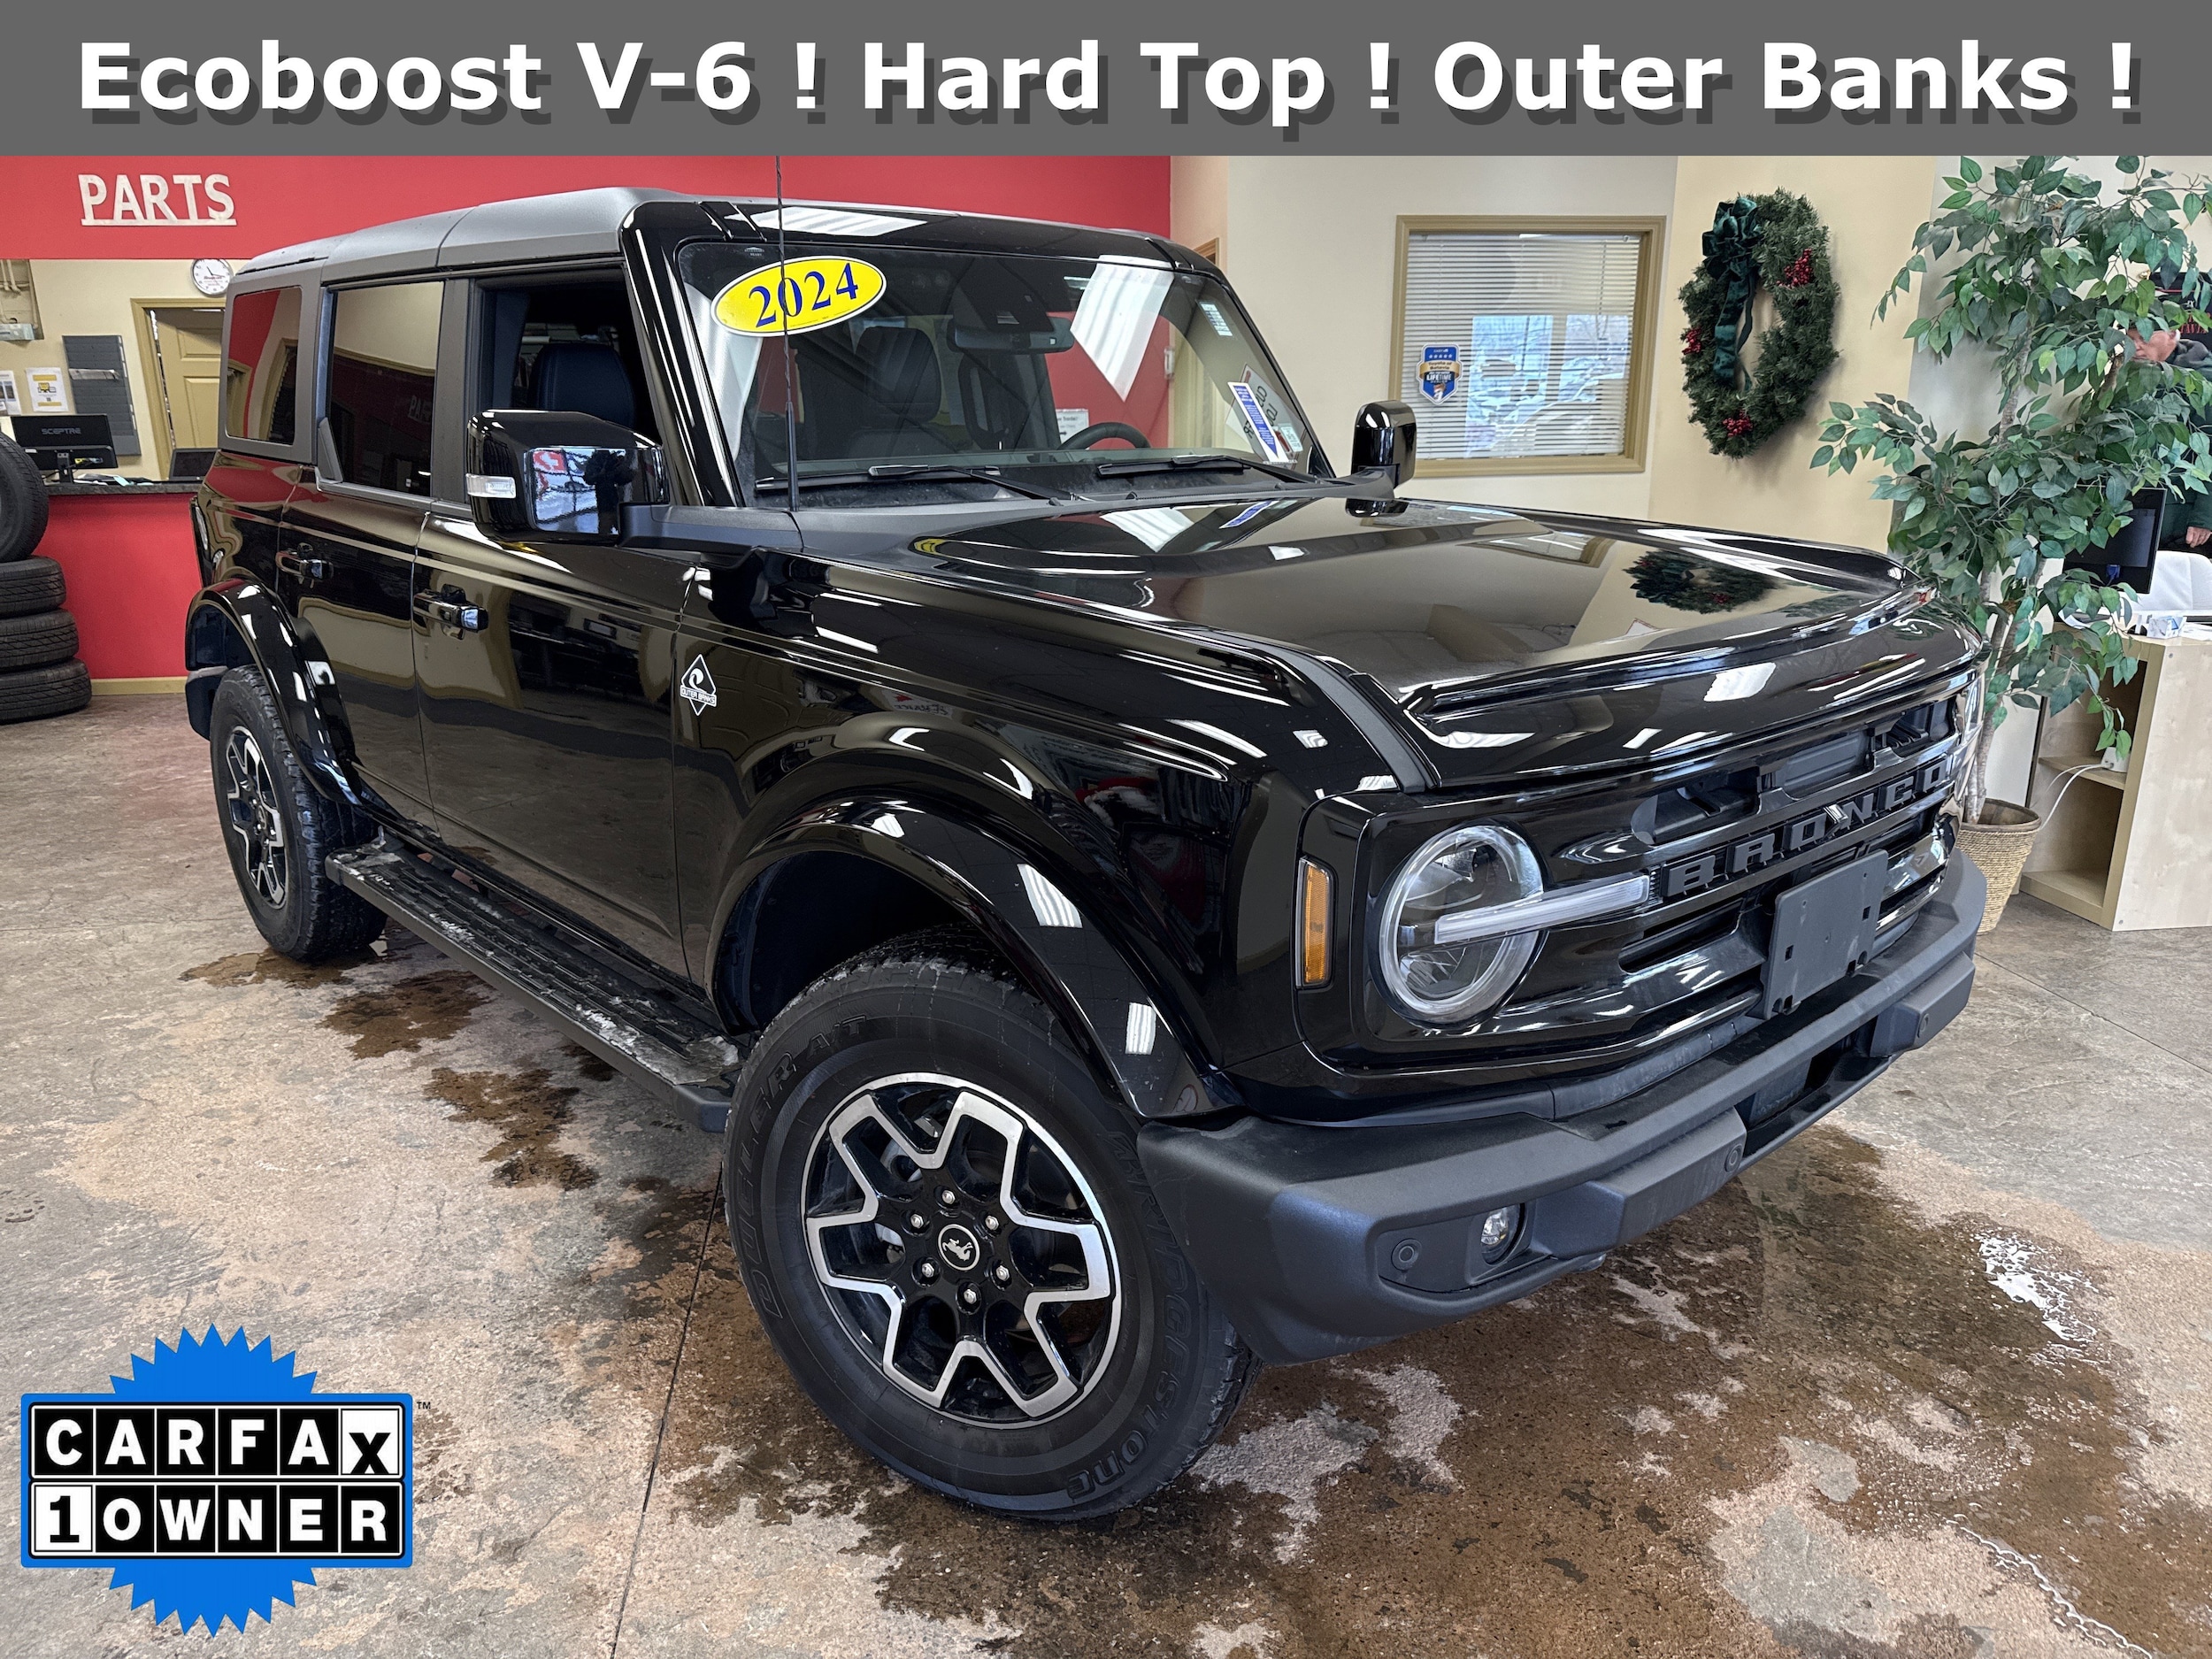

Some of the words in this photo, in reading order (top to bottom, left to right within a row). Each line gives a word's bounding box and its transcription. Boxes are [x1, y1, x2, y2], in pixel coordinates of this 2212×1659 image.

[78, 173, 235, 223] PARTS
[749, 262, 859, 328] 2024
[680, 687, 698, 699] OUTER
[698, 692, 716, 704] BANKS
[1663, 755, 1947, 897] BRONCO
[738, 1051, 797, 1319] DUELER
